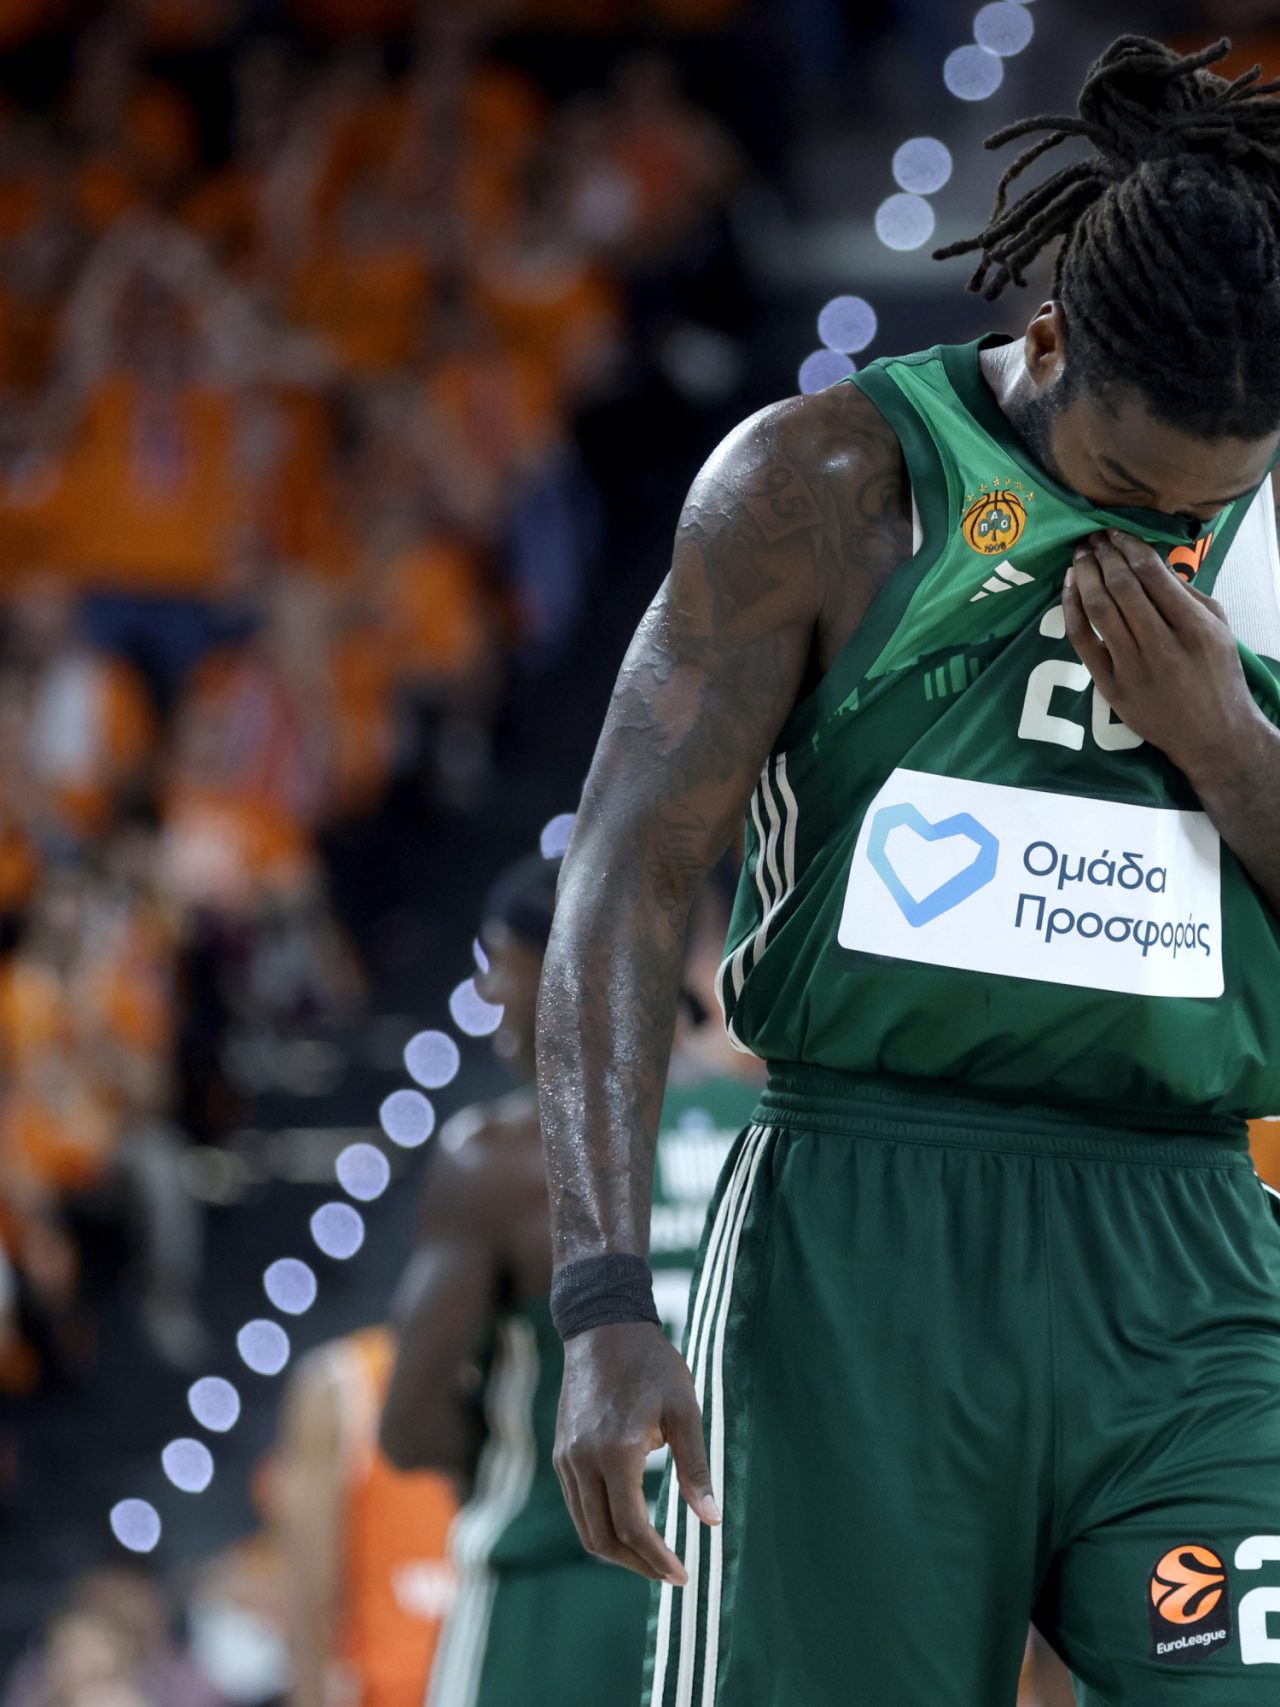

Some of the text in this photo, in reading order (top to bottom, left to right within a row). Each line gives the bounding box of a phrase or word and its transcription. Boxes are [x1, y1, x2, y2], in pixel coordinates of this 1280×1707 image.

[1023, 841, 1167, 893] Ομάδα
[1015, 893, 1211, 959] Προσφοράς
[1157, 1629, 1226, 1655] EuroLeague
